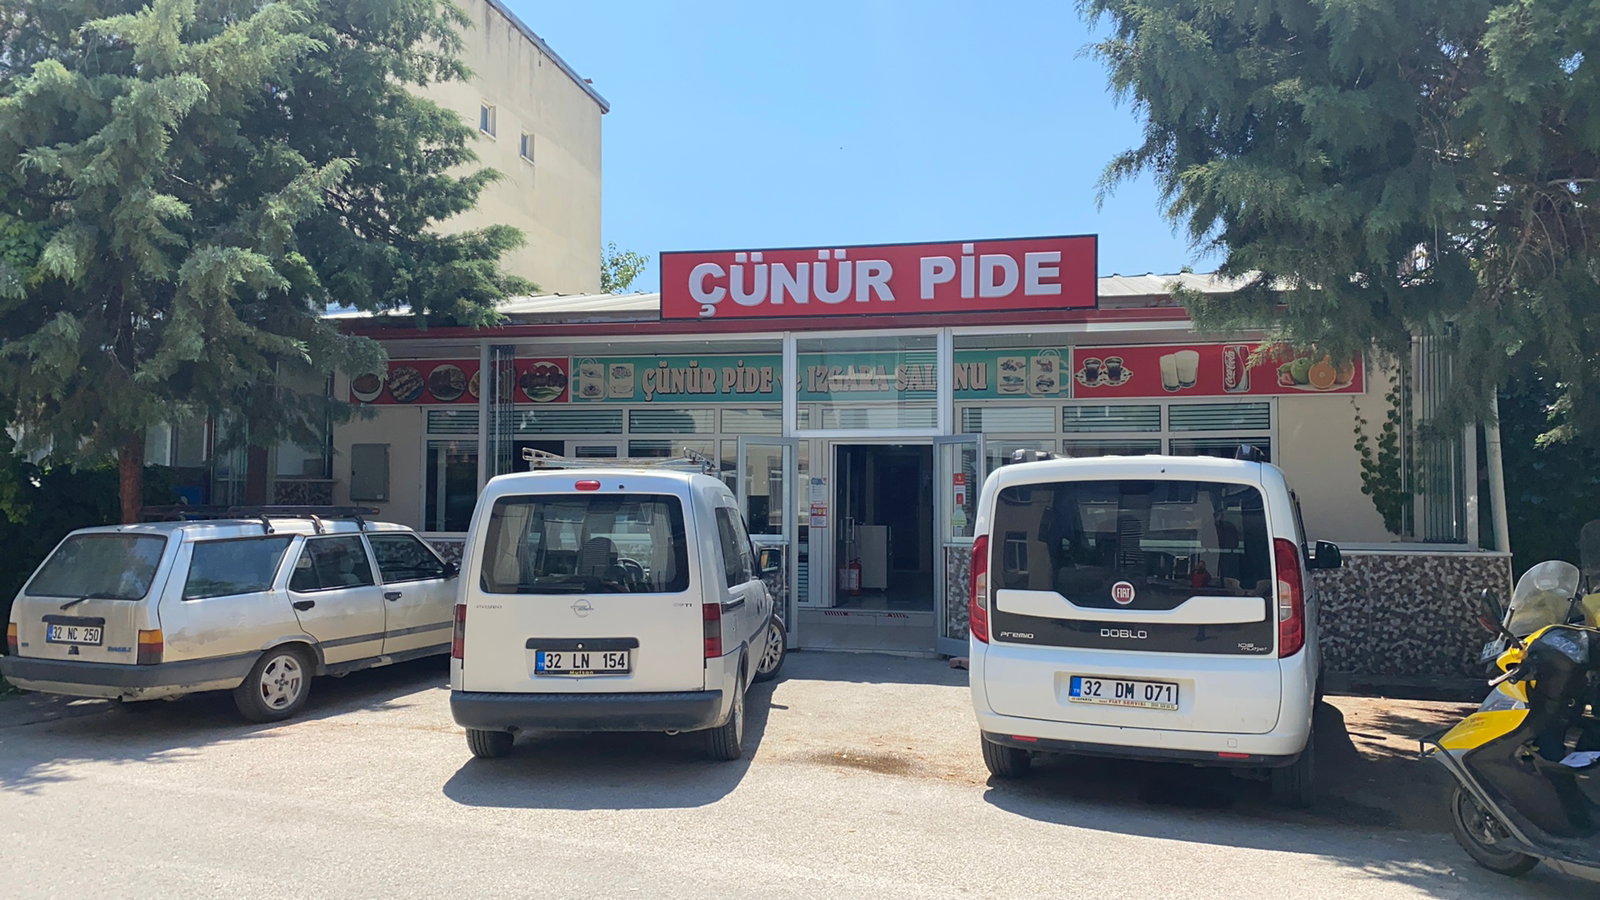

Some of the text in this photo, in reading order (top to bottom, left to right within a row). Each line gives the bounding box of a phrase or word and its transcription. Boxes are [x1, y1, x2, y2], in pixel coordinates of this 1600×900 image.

[688, 242, 1063, 318] ÇÜNÜR PİDE
[641, 359, 717, 402] ÇÜNÜR
[721, 359, 774, 395] PİDE
[894, 362, 988, 393] SALNU
[1116, 587, 1131, 599] FIAT
[53, 626, 62, 640] 32
[67, 627, 78, 641] NC
[83, 628, 99, 642] 250
[1100, 629, 1148, 639] DOBLO
[545, 653, 625, 669] 32 LN 154
[1083, 680, 1172, 702] 32 DM 071
